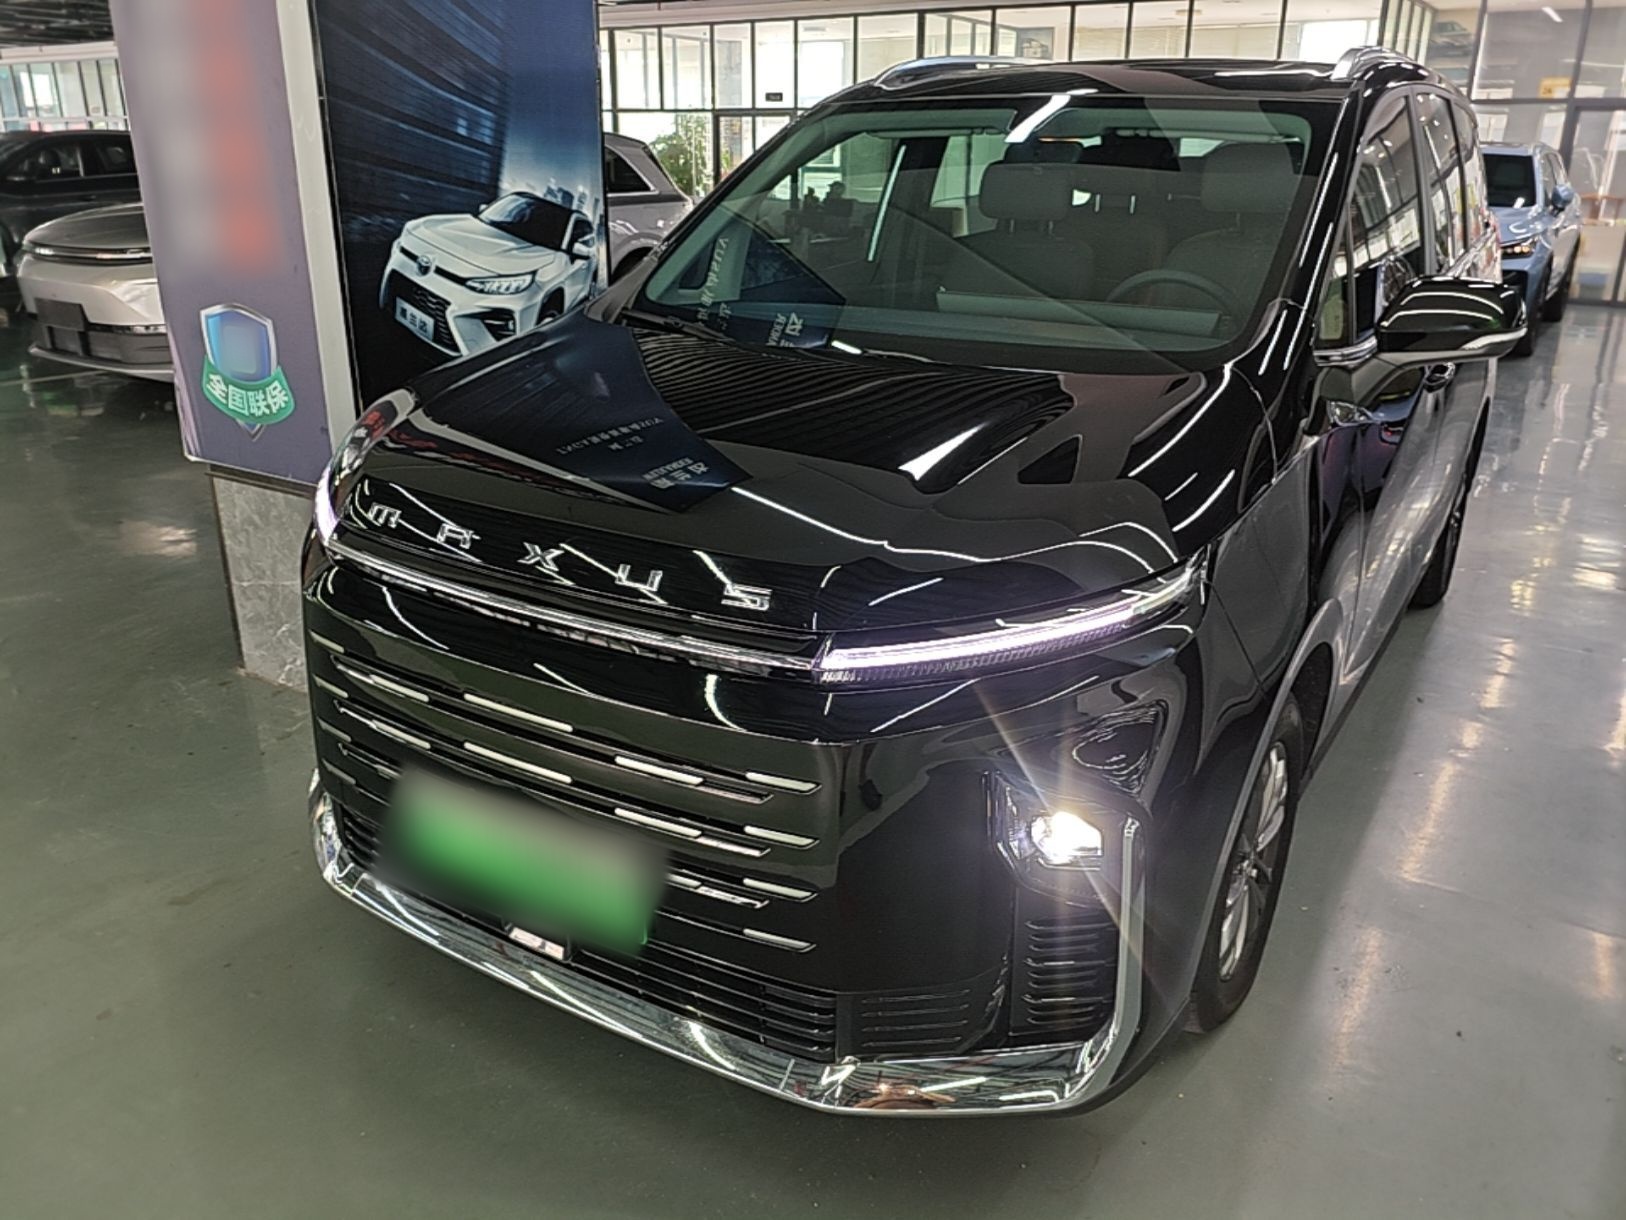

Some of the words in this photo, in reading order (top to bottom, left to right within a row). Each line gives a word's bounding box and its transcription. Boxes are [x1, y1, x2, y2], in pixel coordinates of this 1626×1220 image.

[206, 373, 289, 417] 全国联保
[367, 502, 773, 611] MAXUS
